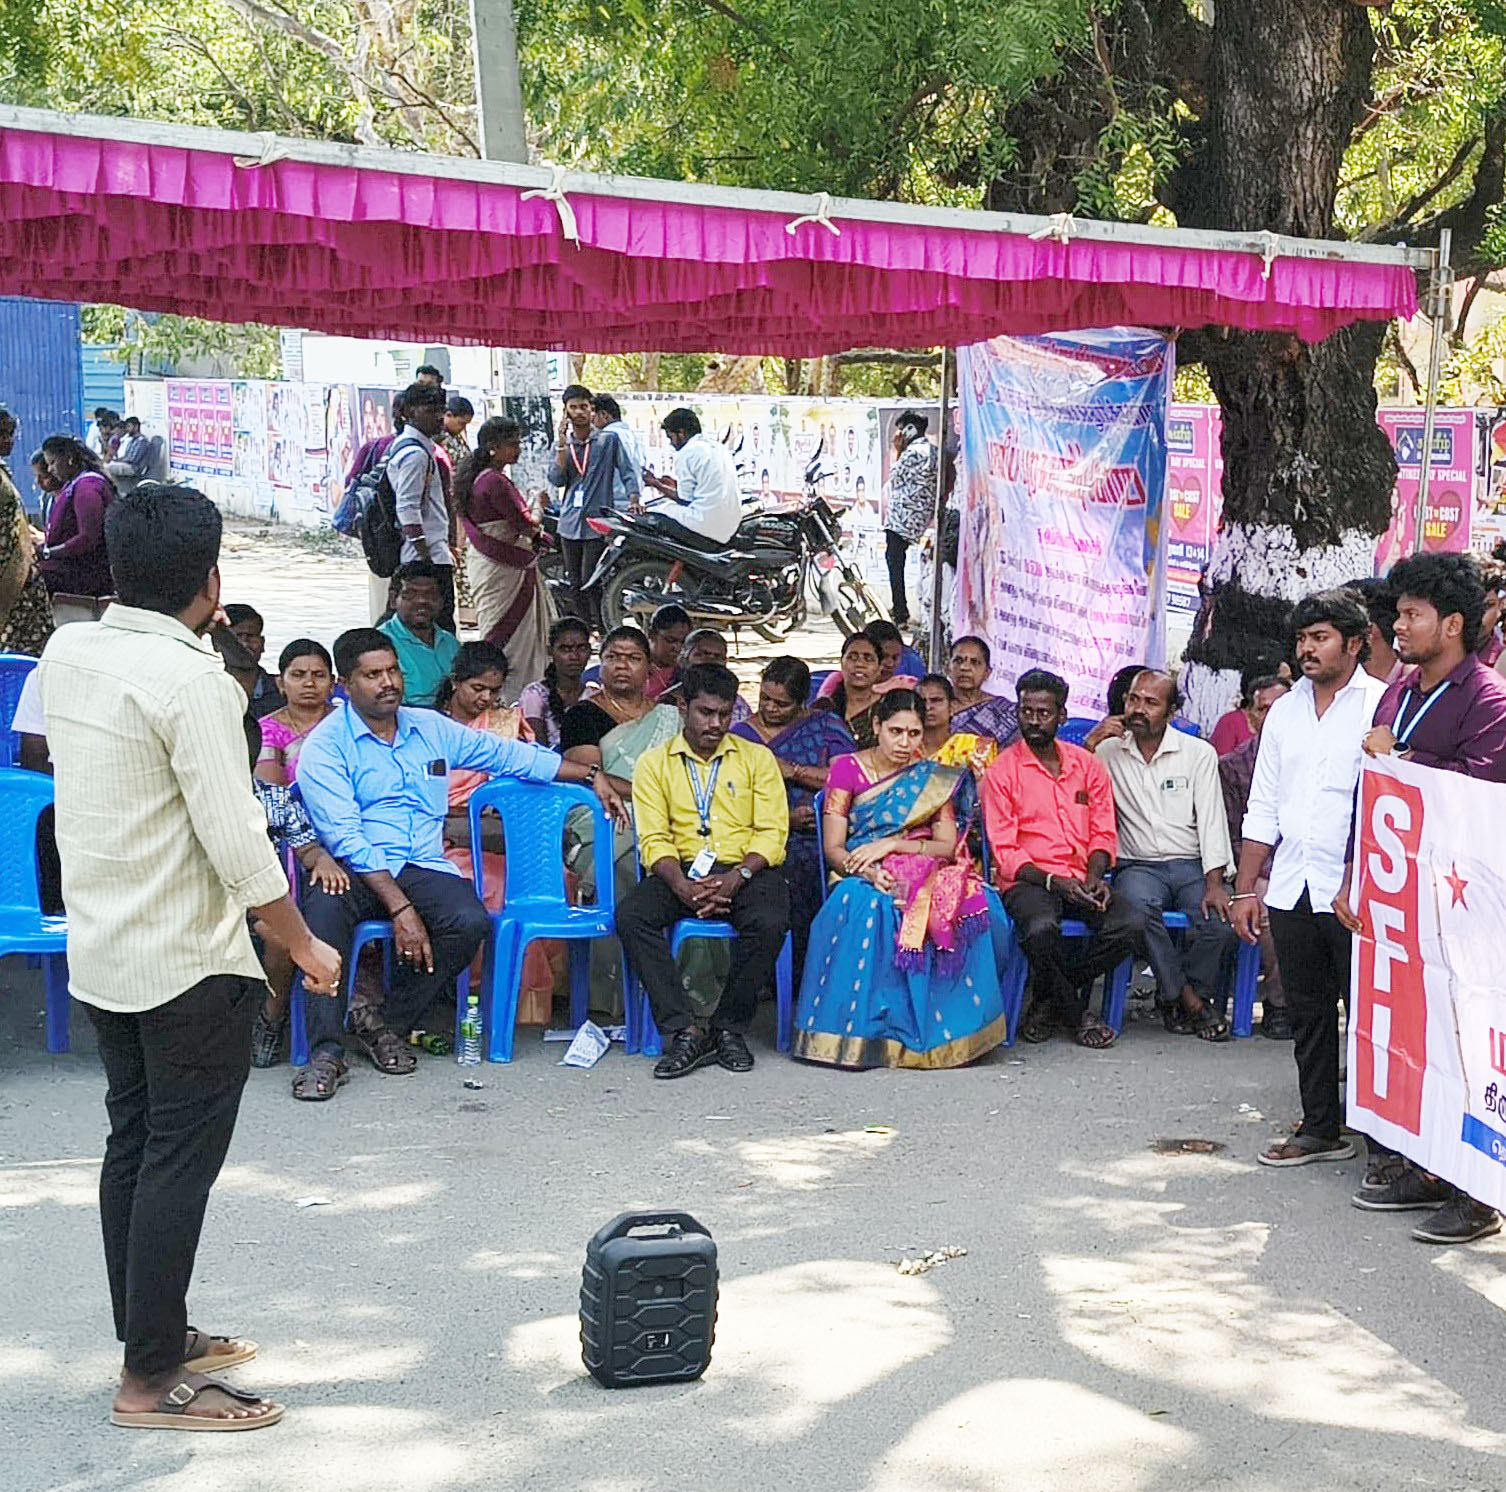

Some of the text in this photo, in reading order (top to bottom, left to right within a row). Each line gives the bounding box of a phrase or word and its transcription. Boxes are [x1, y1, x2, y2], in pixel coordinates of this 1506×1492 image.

[1437, 469, 1467, 482] SPECIAL
[1439, 506, 1460, 522] COST
[1425, 522, 1447, 537] SALE
[1367, 794, 1412, 1100] SFI
